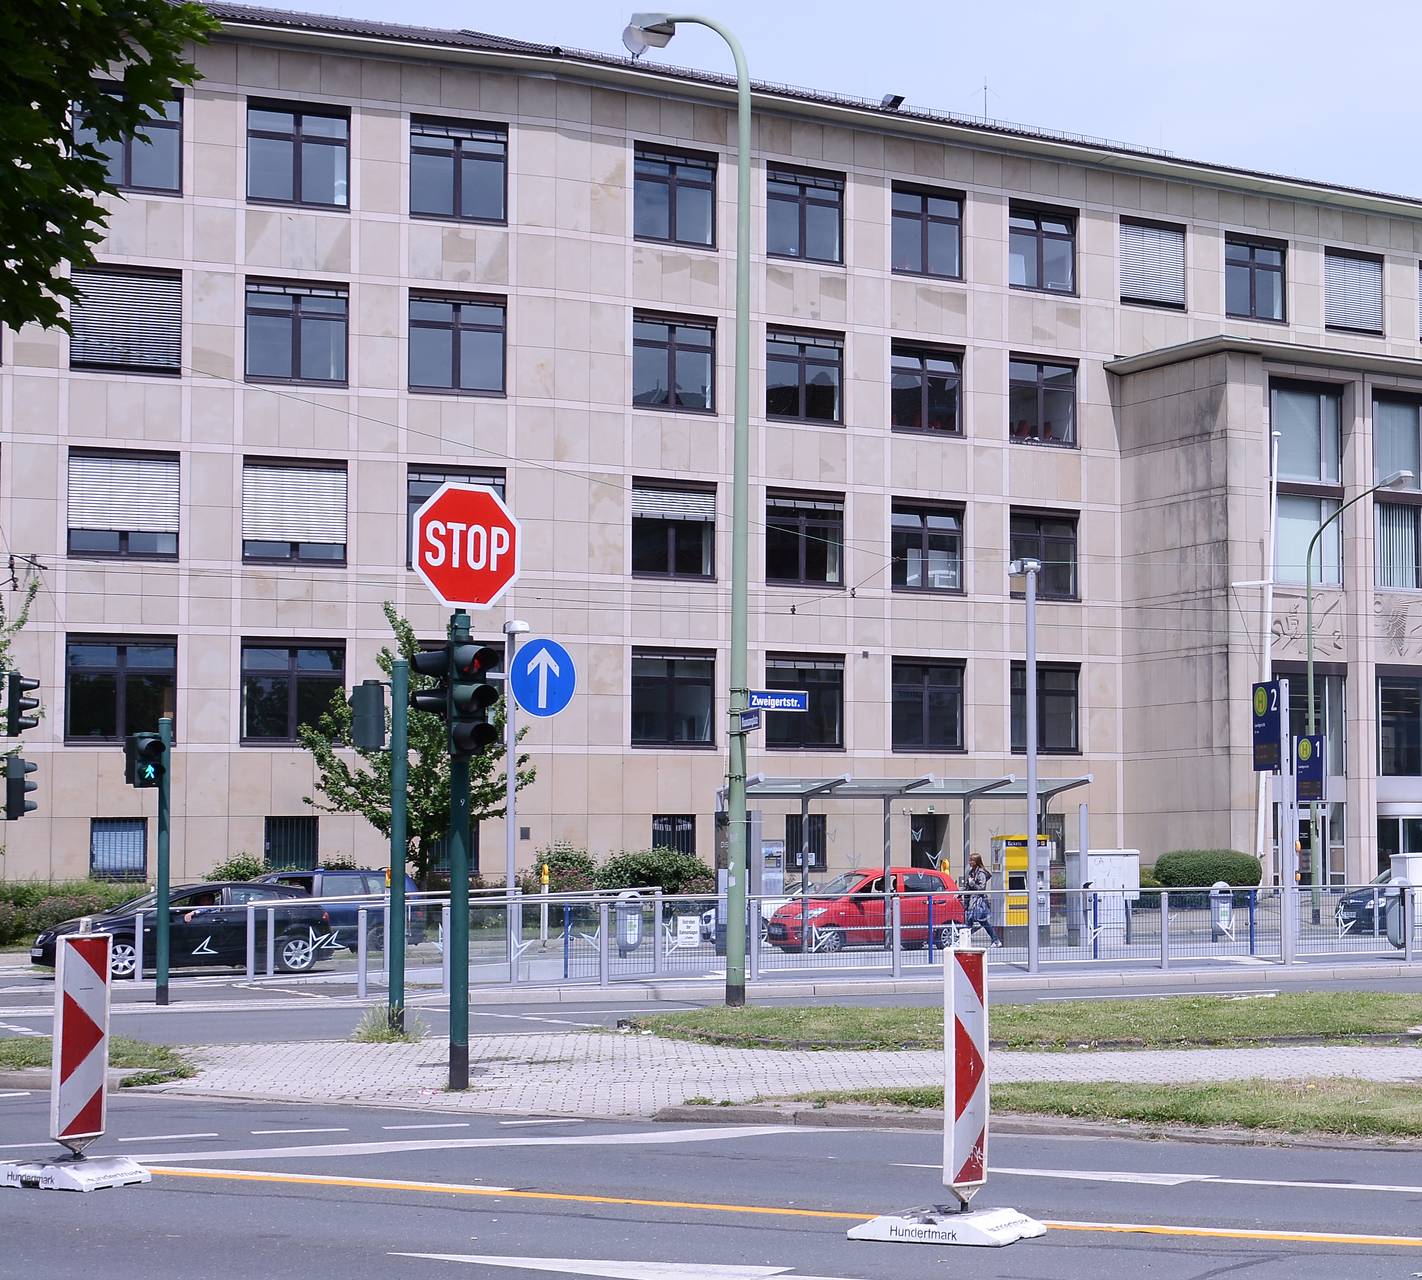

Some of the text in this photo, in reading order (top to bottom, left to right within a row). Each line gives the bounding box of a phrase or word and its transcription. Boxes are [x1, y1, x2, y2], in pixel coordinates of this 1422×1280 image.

[425, 520, 510, 572] STOP
[751, 695, 800, 708] Zweigertstr.
[1270, 688, 1278, 711] 2
[1315, 741, 1320, 758] 1
[7, 1171, 54, 1185] Hundertmark
[889, 1225, 957, 1241] Hundertmark
